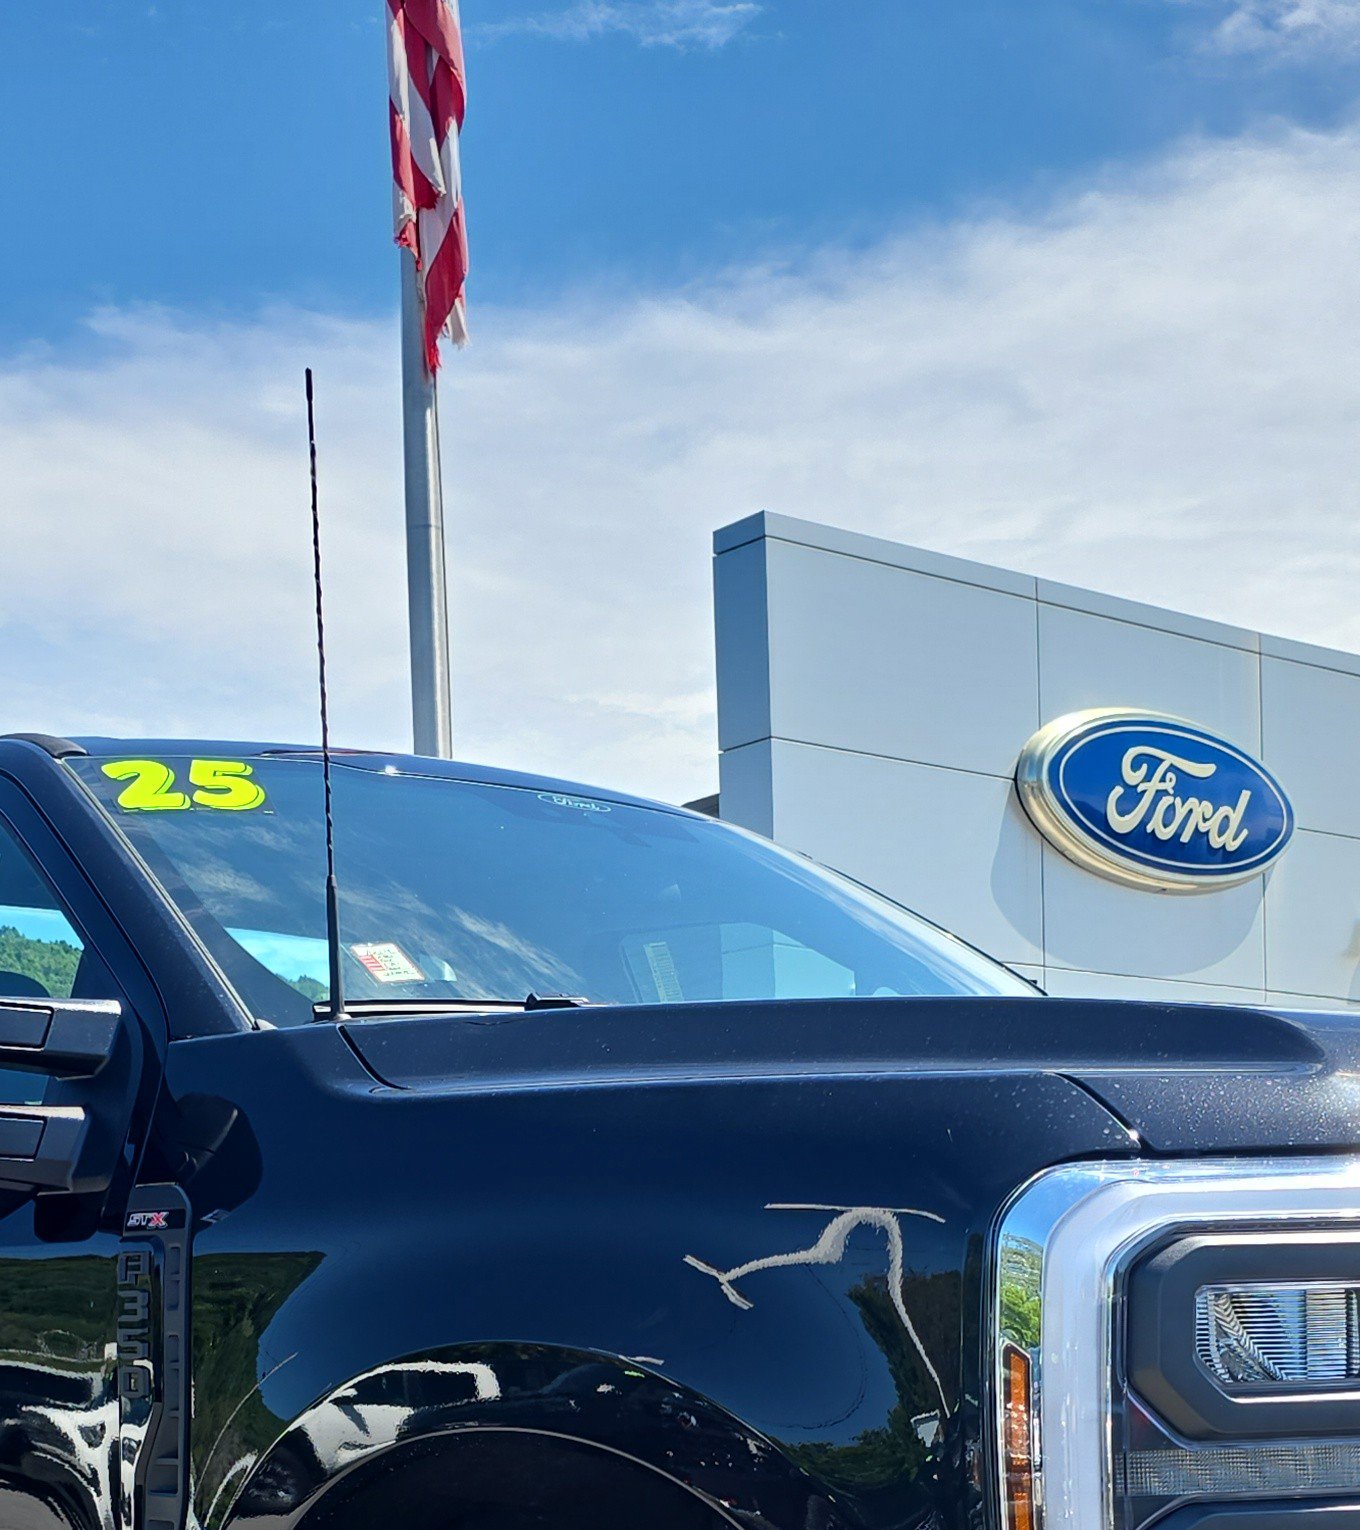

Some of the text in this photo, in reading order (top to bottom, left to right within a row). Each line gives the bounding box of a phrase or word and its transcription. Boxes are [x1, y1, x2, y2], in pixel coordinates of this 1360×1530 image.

[101, 760, 265, 811] 25
[1107, 746, 1251, 851] Ford
[127, 1211, 169, 1229] STX
